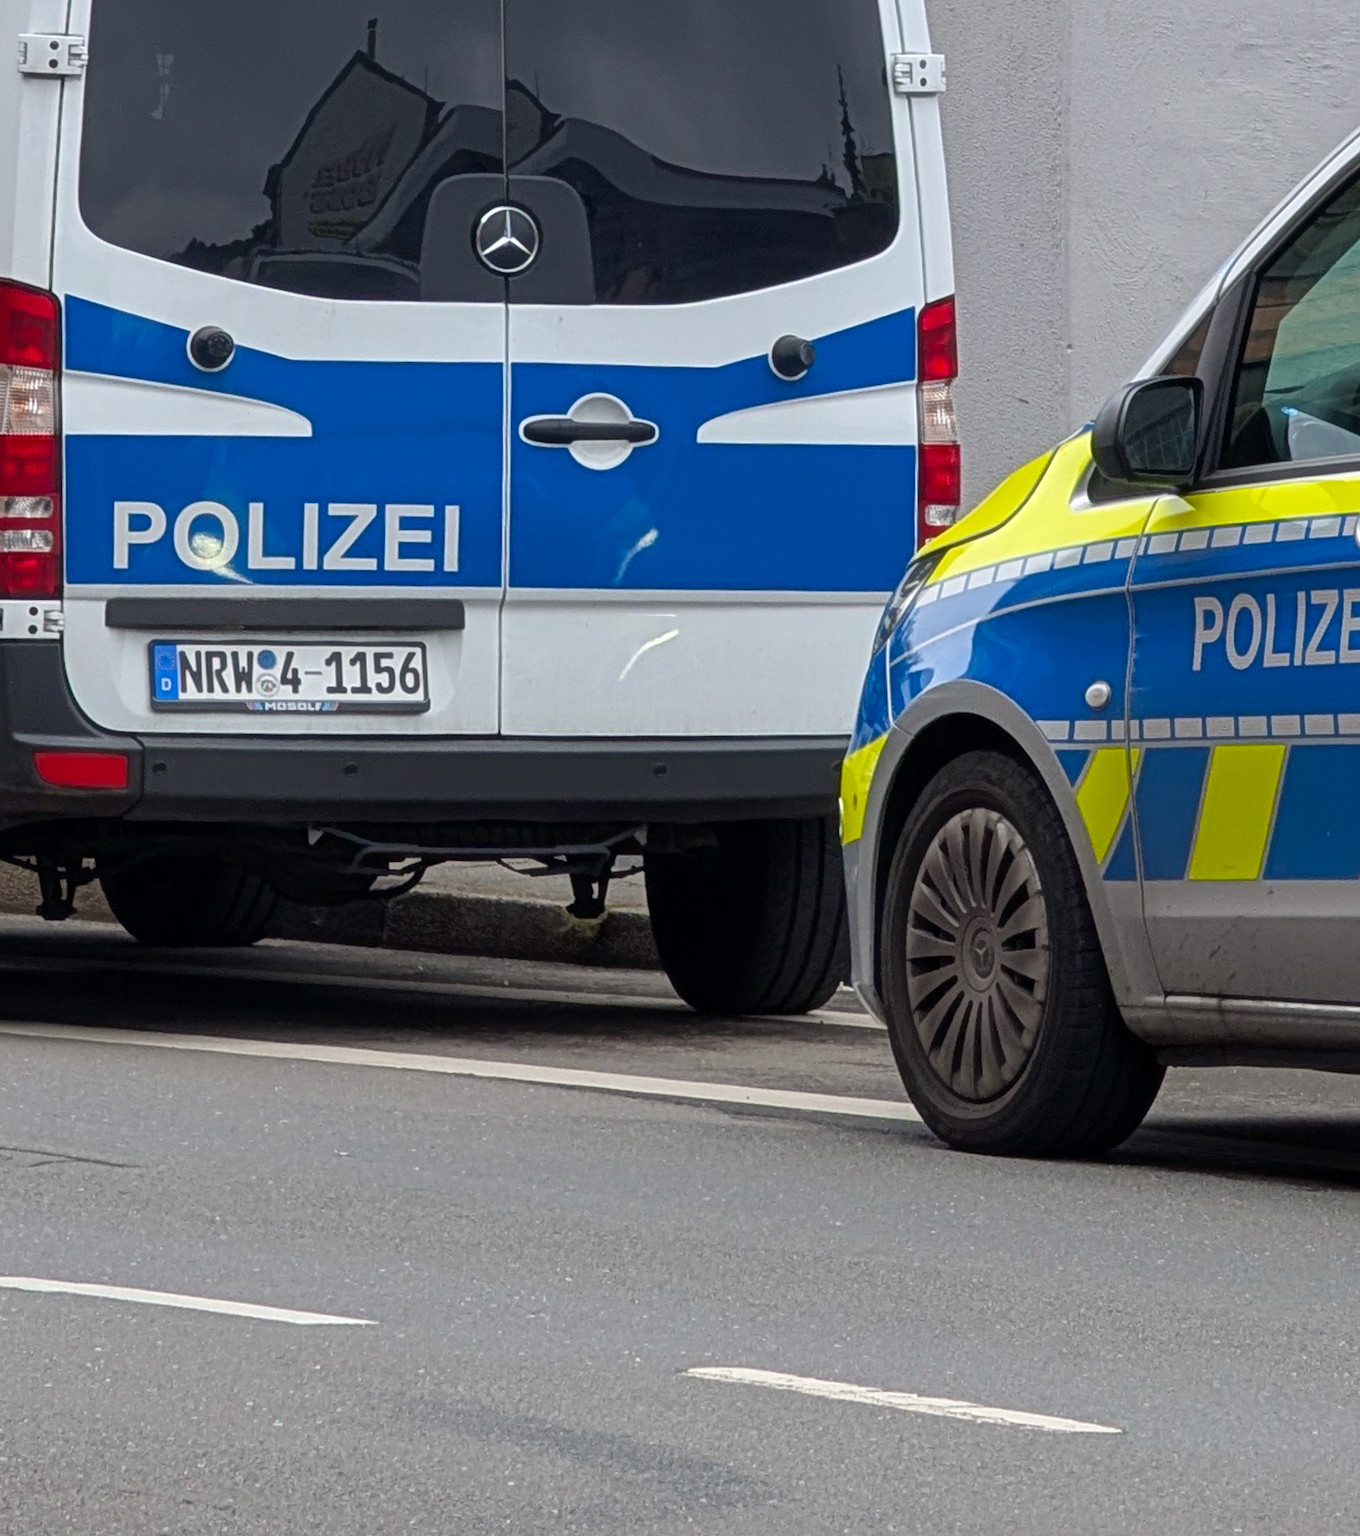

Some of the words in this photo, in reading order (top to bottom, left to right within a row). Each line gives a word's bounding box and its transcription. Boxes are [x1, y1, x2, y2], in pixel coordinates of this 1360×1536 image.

[113, 501, 460, 572] POLIZEI
[161, 678, 171, 691] D
[179, 650, 254, 694] NRW
[280, 651, 420, 694] 4-1156
